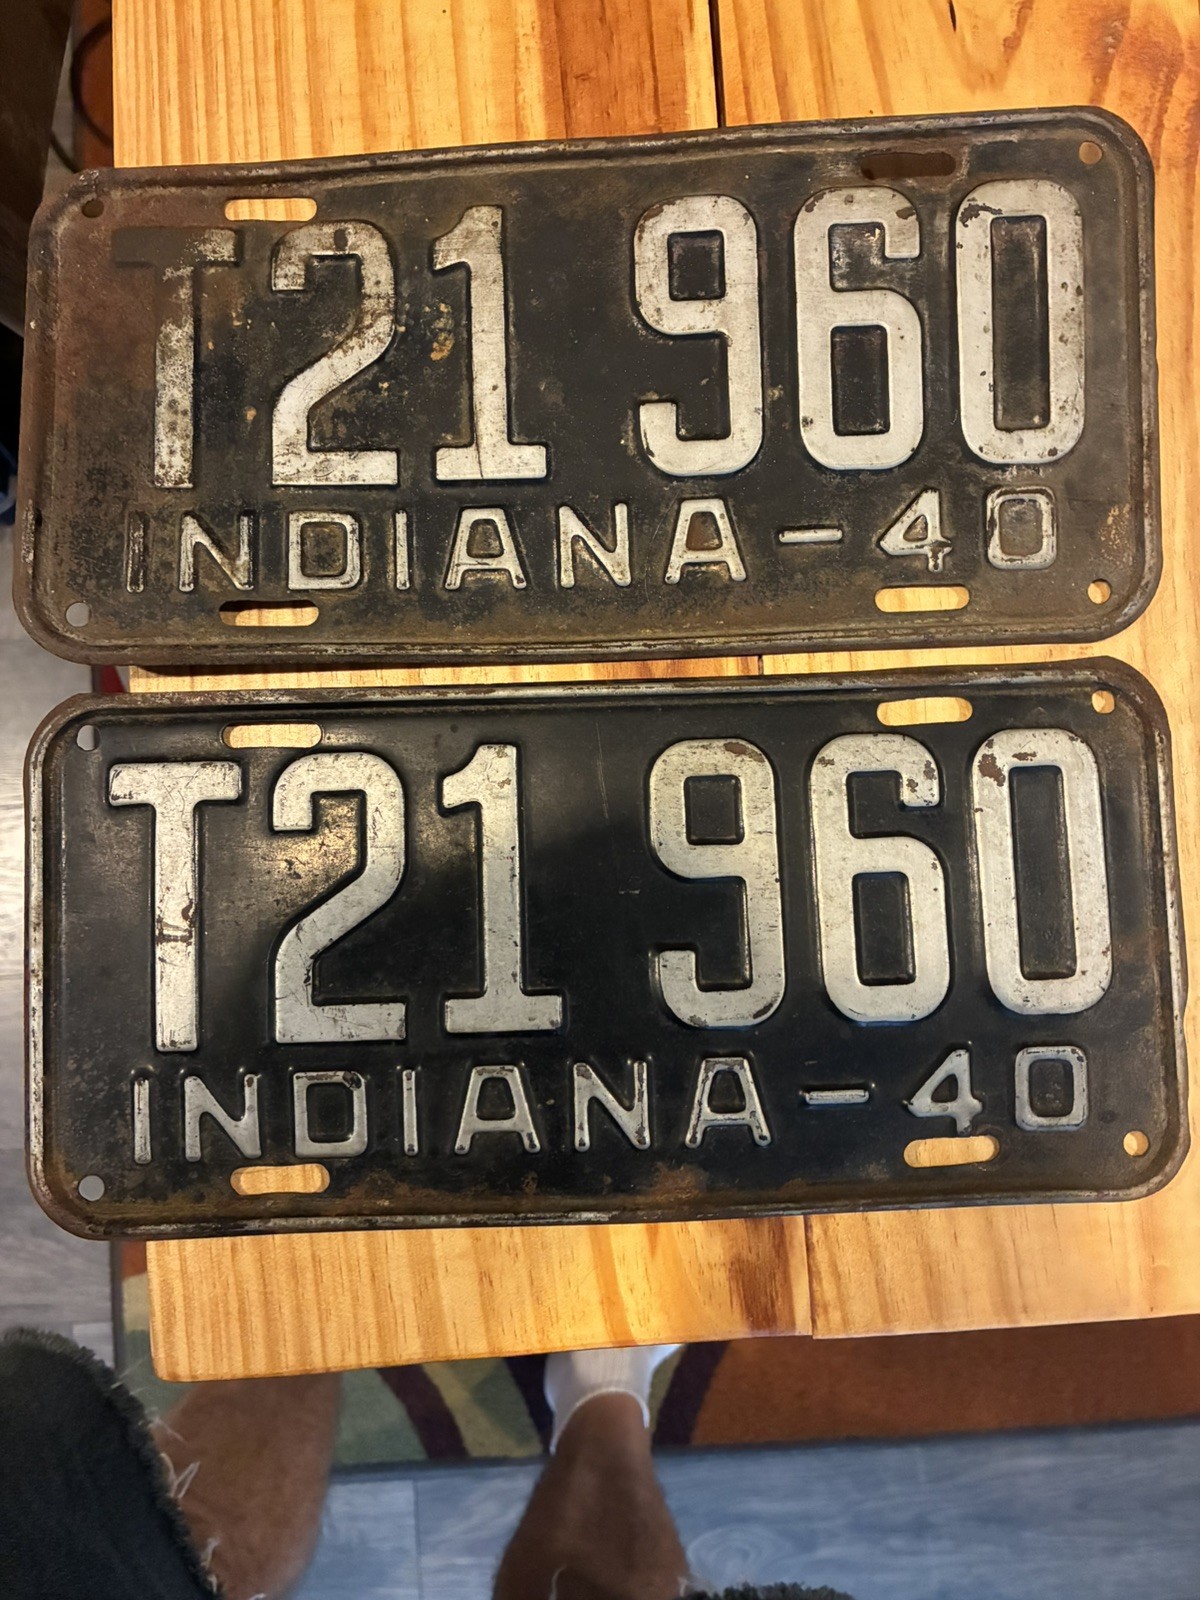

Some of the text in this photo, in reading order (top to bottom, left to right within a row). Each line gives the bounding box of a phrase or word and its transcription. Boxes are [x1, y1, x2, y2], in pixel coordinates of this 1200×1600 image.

[113, 178, 1087, 490] T21 960
[108, 728, 1114, 1053] T21 960
